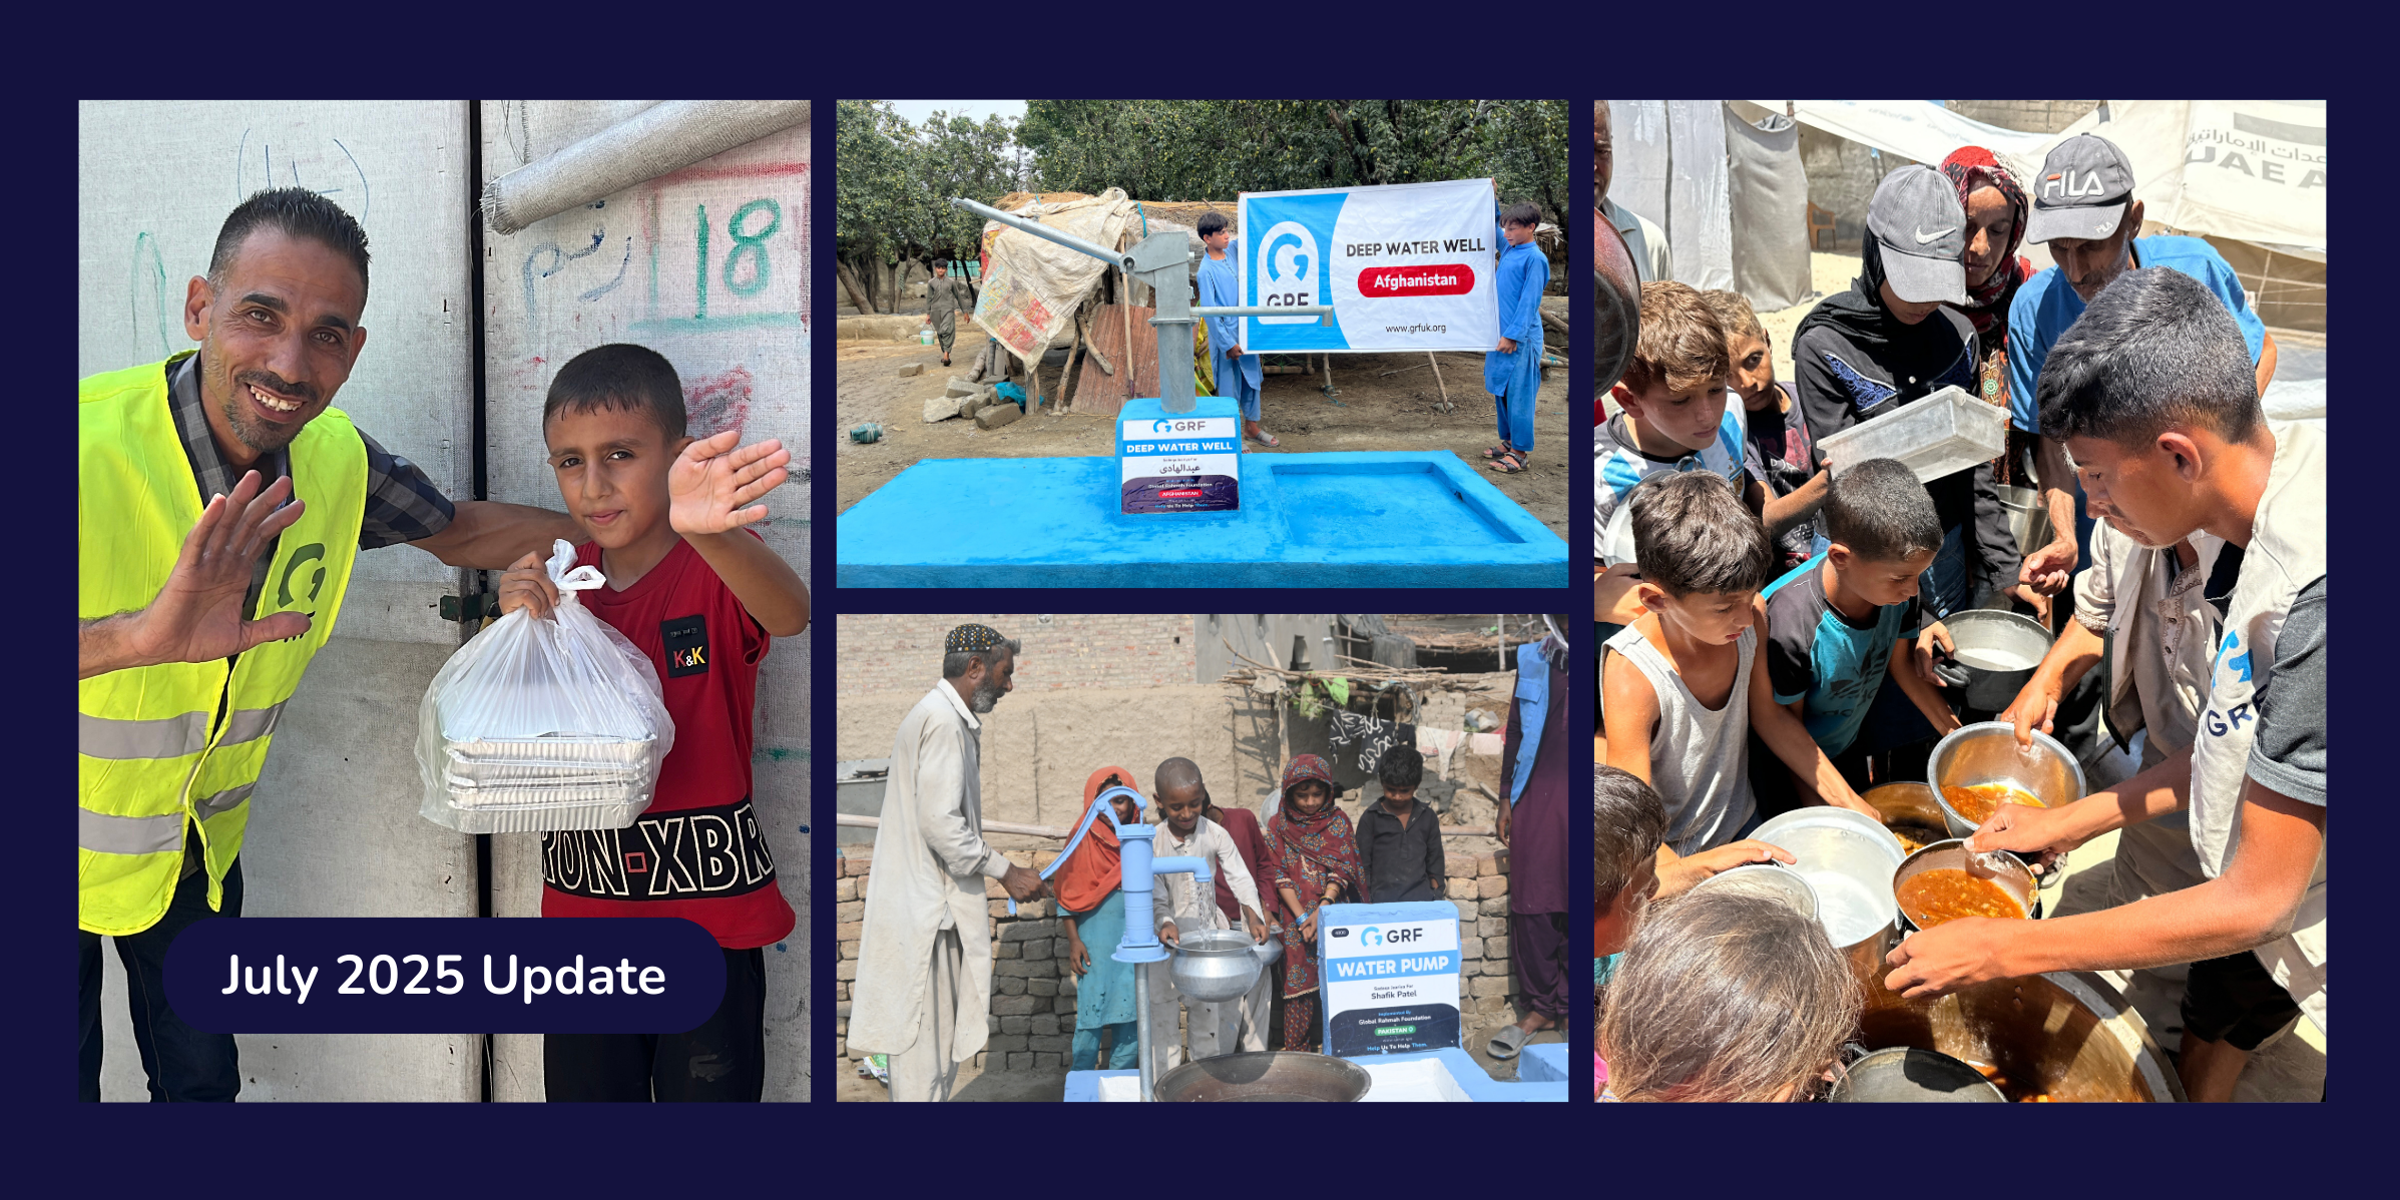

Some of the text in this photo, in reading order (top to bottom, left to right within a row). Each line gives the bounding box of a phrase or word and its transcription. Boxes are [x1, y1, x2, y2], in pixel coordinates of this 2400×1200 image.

[2184, 146, 2285, 185] UAE
[2043, 170, 2105, 200] FILA
[2094, 221, 2114, 233] FILA
[1346, 238, 1486, 257] DEEP WATER WELL
[695, 198, 781, 319] 18
[1374, 273, 1457, 291] Afghanistan
[1385, 323, 1447, 334] www.grfuk.org
[1175, 421, 1206, 431] GRF
[1126, 442, 1233, 453] DEEP WATER WELL
[673, 645, 706, 669] K&K
[2208, 684, 2268, 737] GRF
[1387, 928, 1423, 943] GRF
[1336, 956, 1449, 977] WATER PUMP
[1371, 990, 1417, 1000] Shafik Patel
